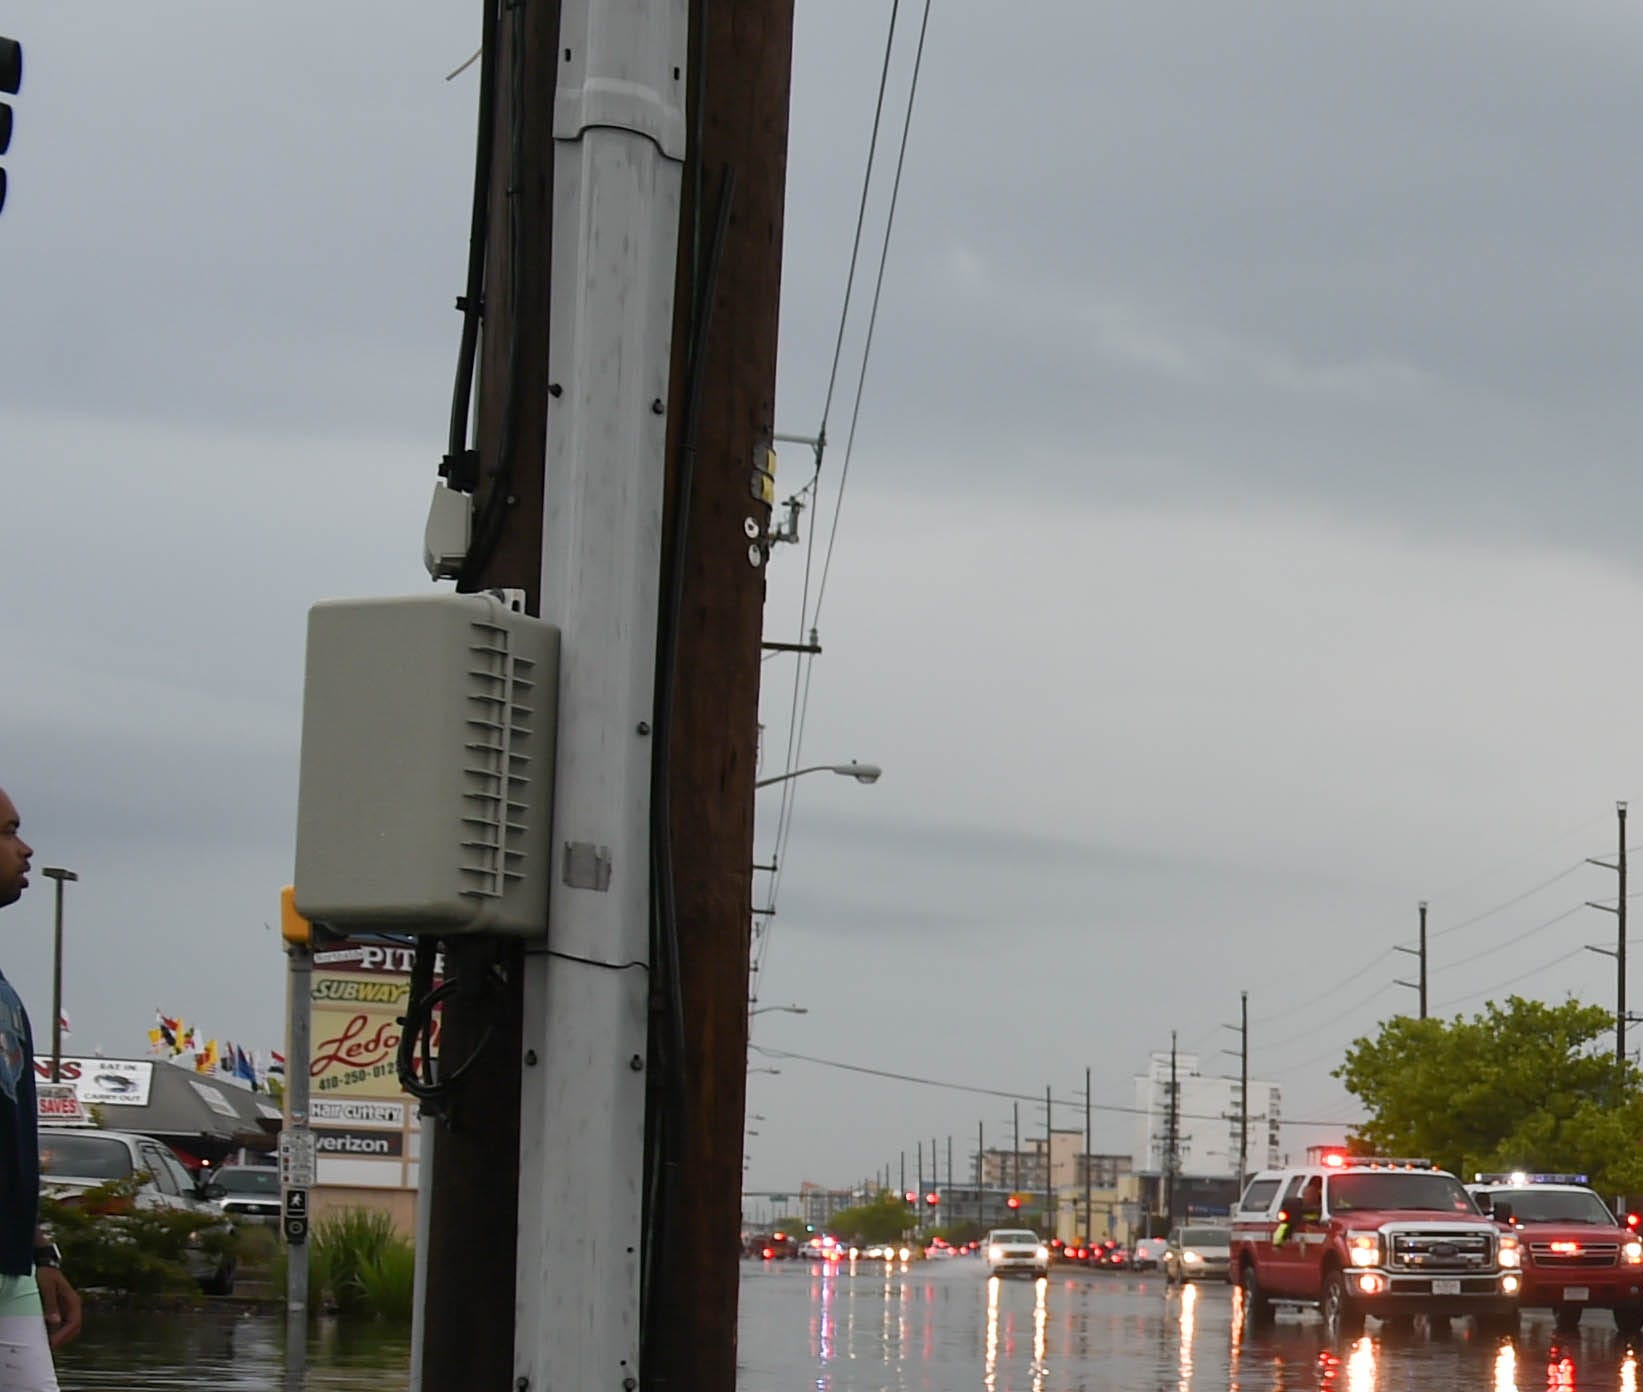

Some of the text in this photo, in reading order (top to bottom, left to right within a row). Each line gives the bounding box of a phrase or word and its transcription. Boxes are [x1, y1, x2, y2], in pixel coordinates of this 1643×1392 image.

[311, 980, 411, 1003] SUBWAY
[310, 1015, 400, 1077] Ledo
[40, 1098, 77, 1113] SAVES
[316, 1134, 389, 1153] verizon
